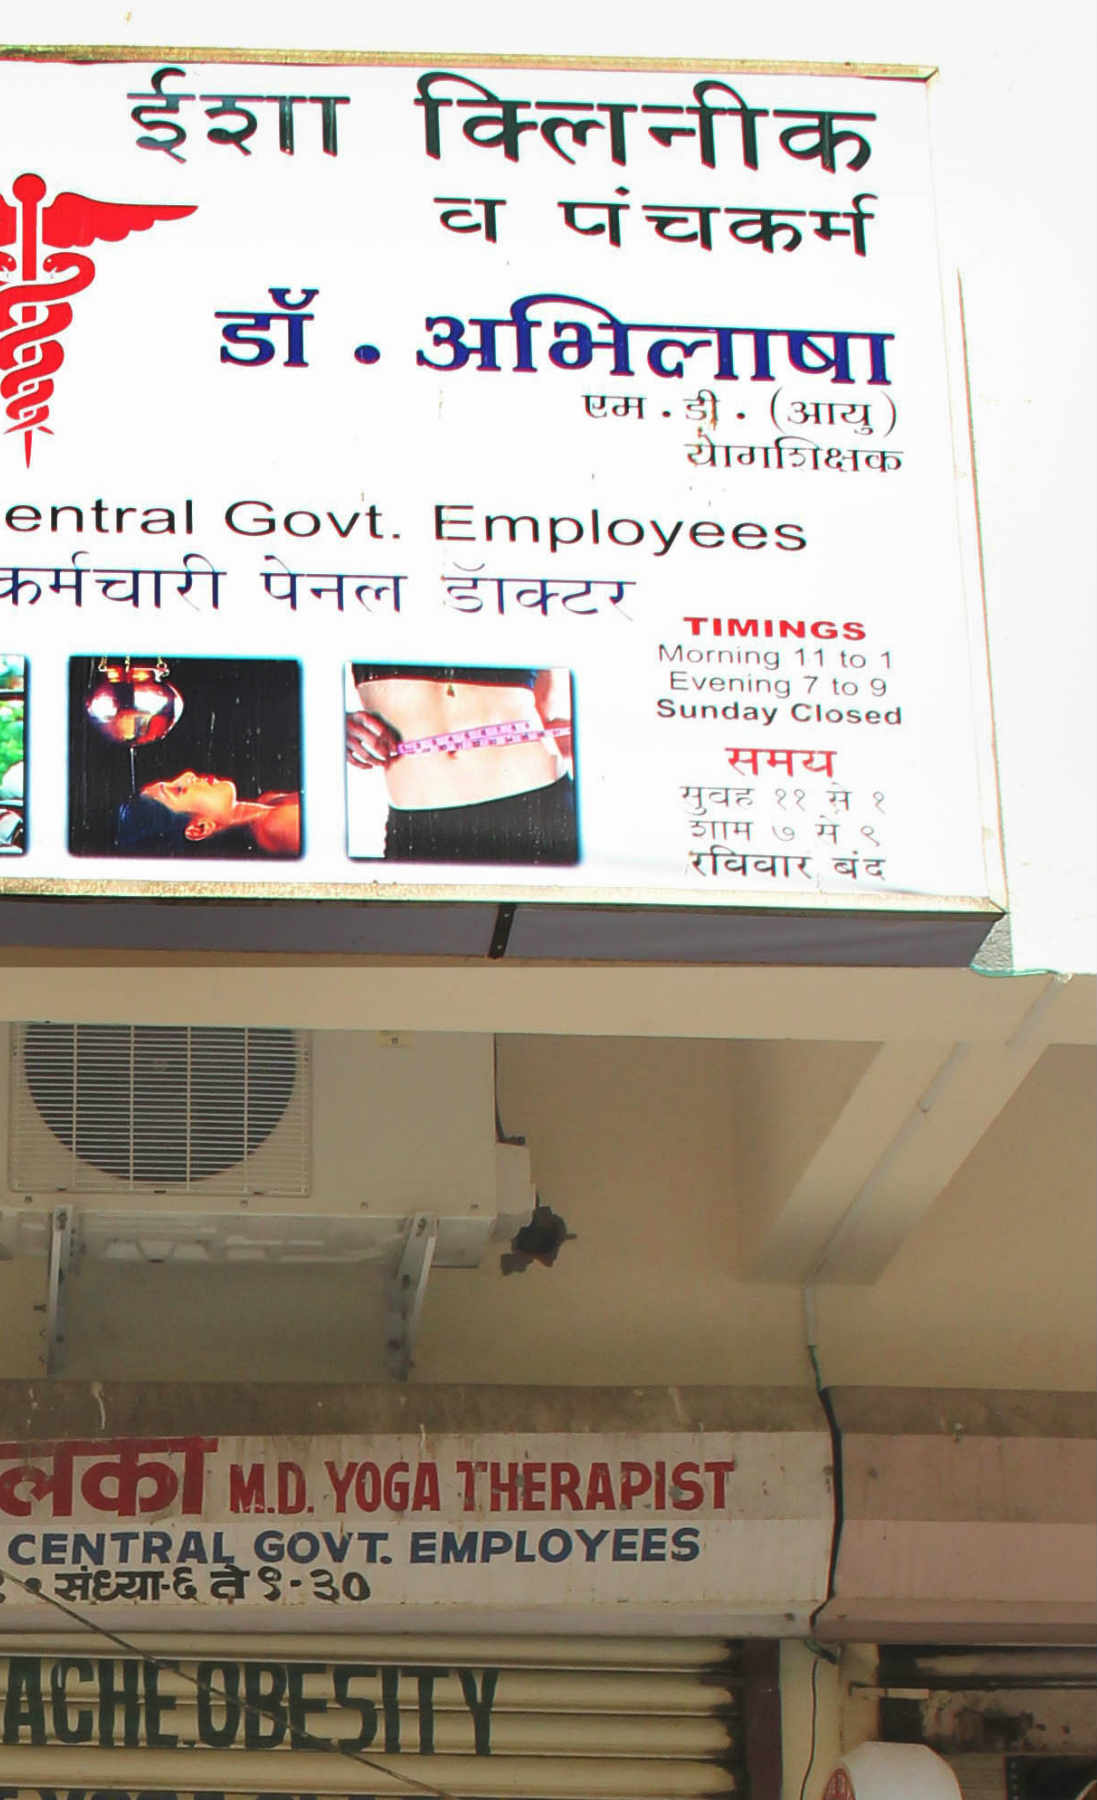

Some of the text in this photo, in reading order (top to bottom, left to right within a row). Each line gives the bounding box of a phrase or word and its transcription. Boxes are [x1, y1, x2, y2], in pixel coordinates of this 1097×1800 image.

[126, 66, 351, 163] ईशा
[434, 186, 877, 256] व पंचकर्म
[415, 293, 896, 385] अभिलाषा
[225, 501, 400, 538] Govt.
[435, 505, 806, 556] Employees
[260, 555, 407, 612] पेनल
[684, 617, 865, 640] TIMINGS
[658, 643, 890, 670] Morning 11 to 1
[669, 670, 887, 699] Evening 7 to 9
[656, 698, 902, 726] Sunday Closed
[724, 747, 837, 778] समय
[688, 844, 886, 880] रविवार बंद
[229, 1458, 736, 1516] M.D. YOGA THERAPIST
[7, 1528, 236, 1566] CENTRAL
[254, 1529, 394, 1566] GOVT.
[409, 1527, 701, 1565] EMPLOYEES
[195, 1661, 501, 1756] OBESITY
